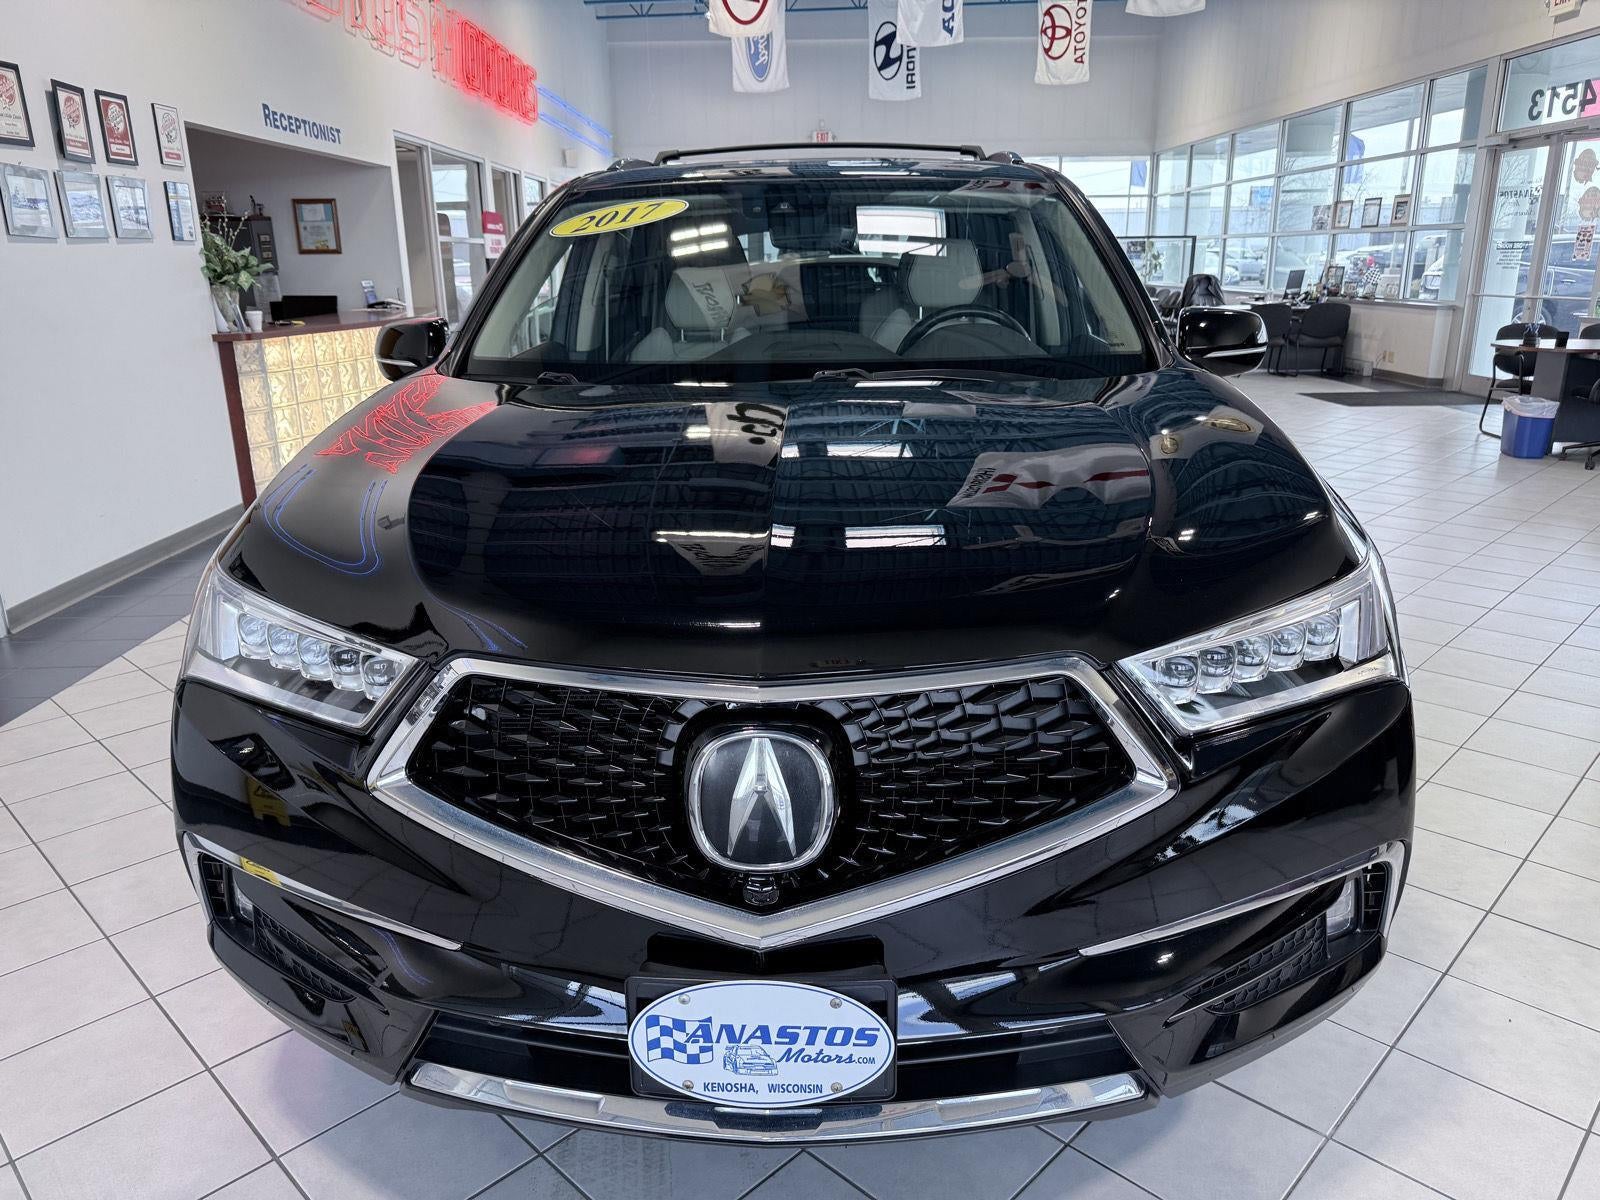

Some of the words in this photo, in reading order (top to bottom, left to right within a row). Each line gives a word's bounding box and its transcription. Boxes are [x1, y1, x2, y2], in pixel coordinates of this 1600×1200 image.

[262, 103, 341, 145] RECEPTIONIST
[816, 131, 829, 143] EXIT
[570, 201, 665, 233] 2017
[683, 1022, 880, 1047] ANASTOS
[703, 1082, 759, 1095] KENOSHA,
[768, 1083, 823, 1094] WISCONSIN
